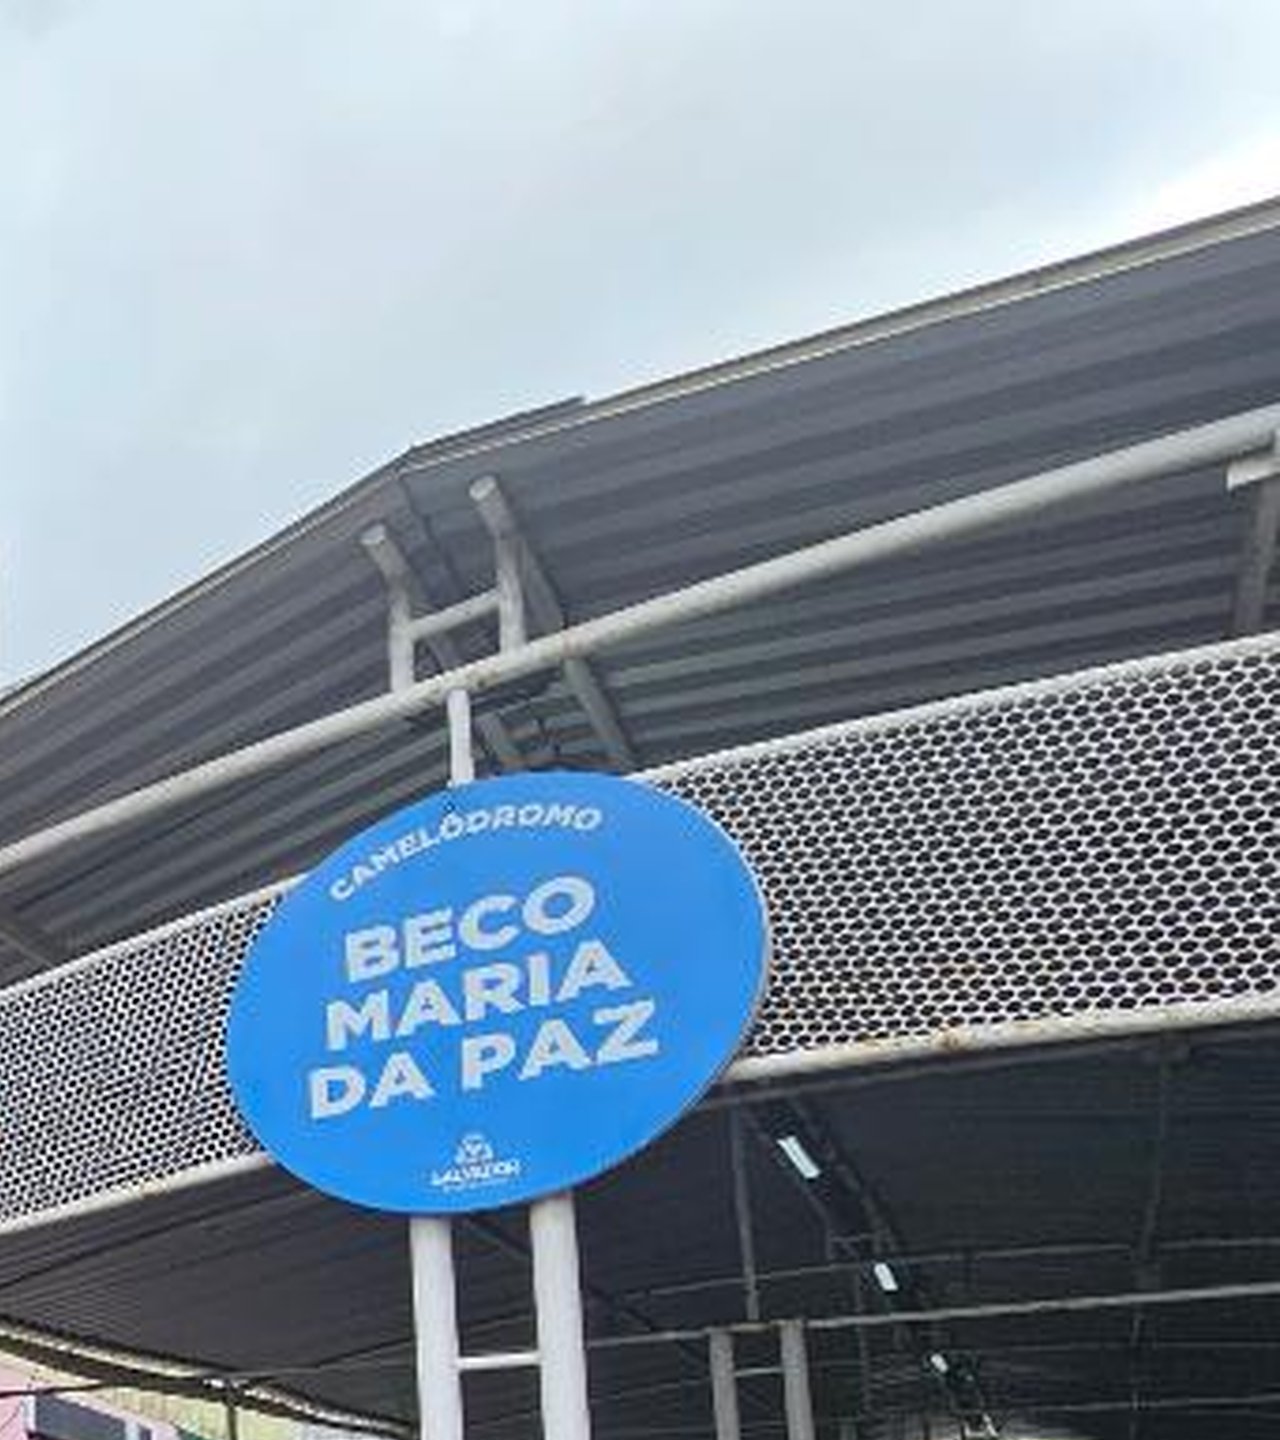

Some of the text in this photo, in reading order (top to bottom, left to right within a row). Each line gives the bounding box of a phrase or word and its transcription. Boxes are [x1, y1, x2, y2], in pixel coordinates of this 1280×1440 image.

[344, 876, 596, 984] BECO
[325, 940, 634, 1052] MARIA
[309, 998, 660, 1120] DA PAZ
